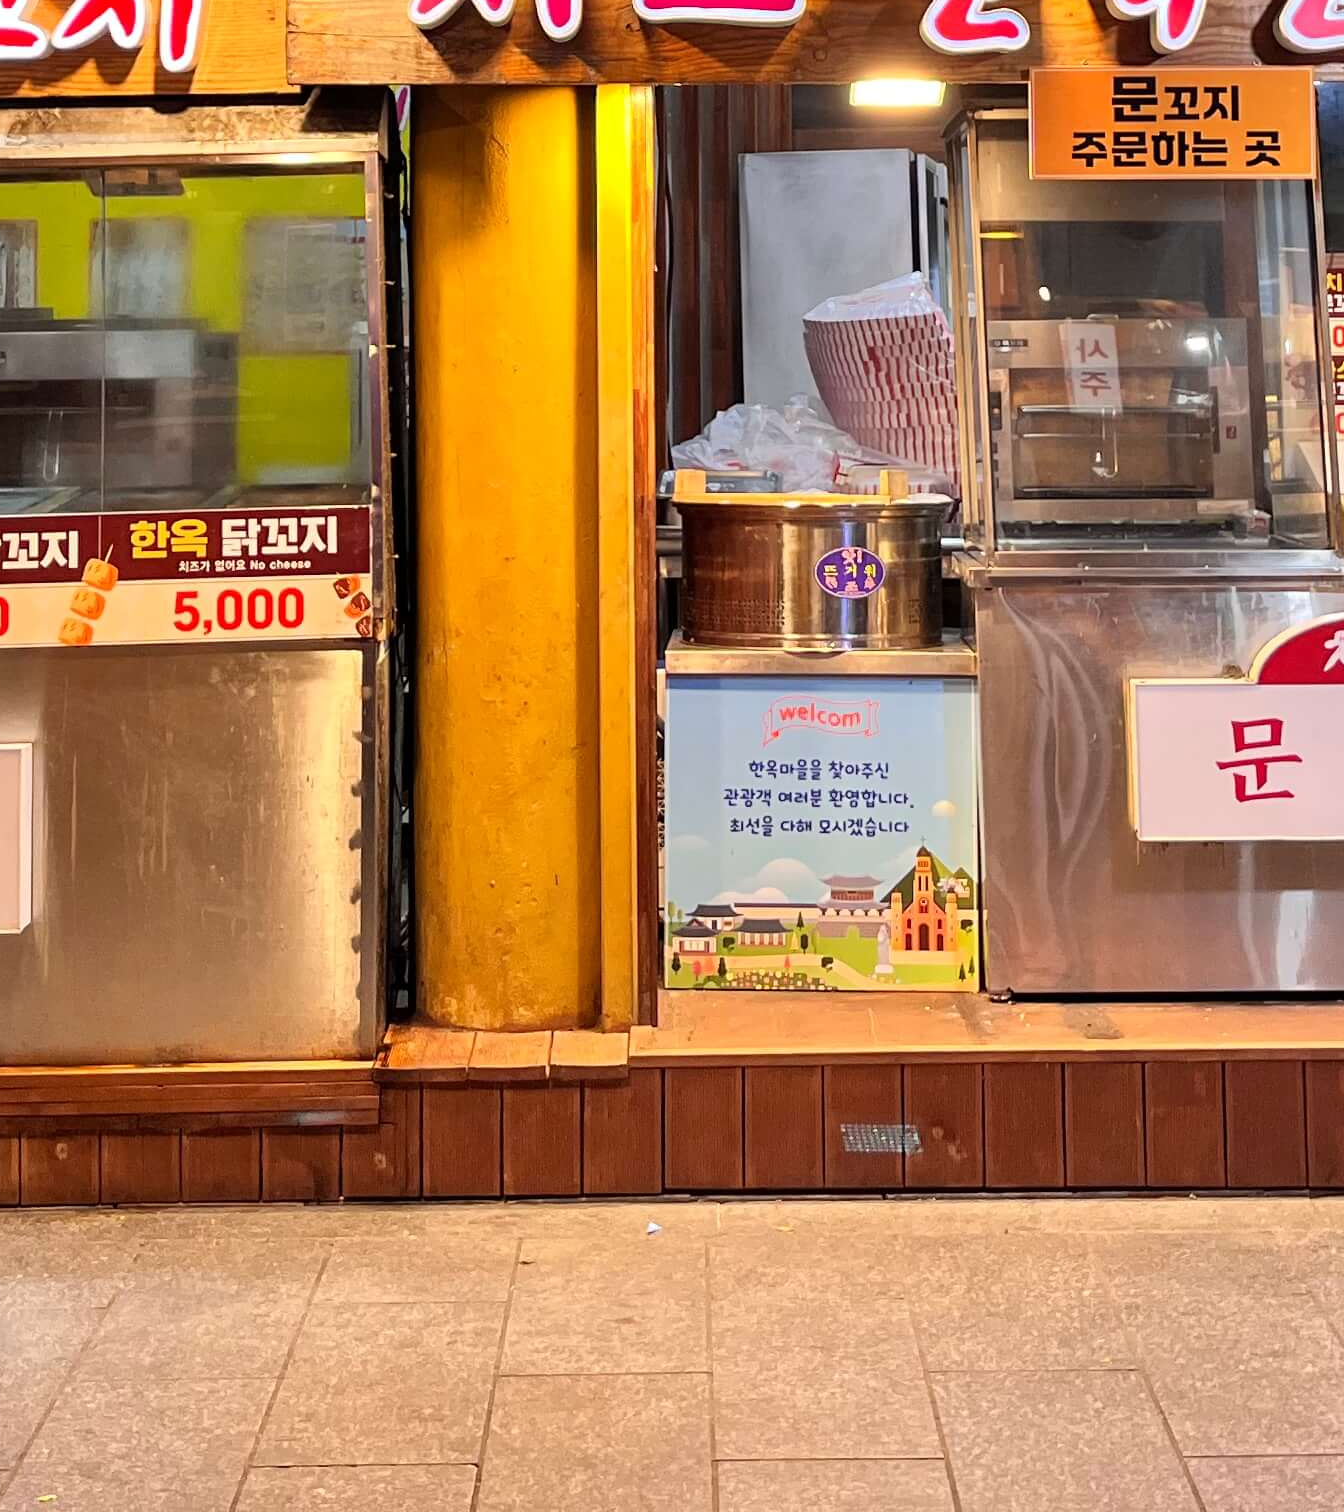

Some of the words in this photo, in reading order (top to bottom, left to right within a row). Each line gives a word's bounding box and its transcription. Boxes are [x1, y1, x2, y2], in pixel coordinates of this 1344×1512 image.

[1111, 76, 1240, 123] 문꼬지
[1071, 131, 1229, 168] 주문하는
[1244, 131, 1281, 167] 곳
[130, 520, 209, 560] 한옥
[220, 515, 338, 557] 닭꼬지
[250, 560, 266, 570] No
[173, 587, 305, 634] 5,000
[749, 759, 822, 780] 한옥마을을
[828, 760, 889, 780] 찾아주신
[723, 788, 772, 808] 관광객
[778, 789, 822, 808] 여러분
[730, 815, 774, 837] 최선을
[781, 818, 813, 833] 다해
[819, 817, 910, 838] 모시겠습니다
